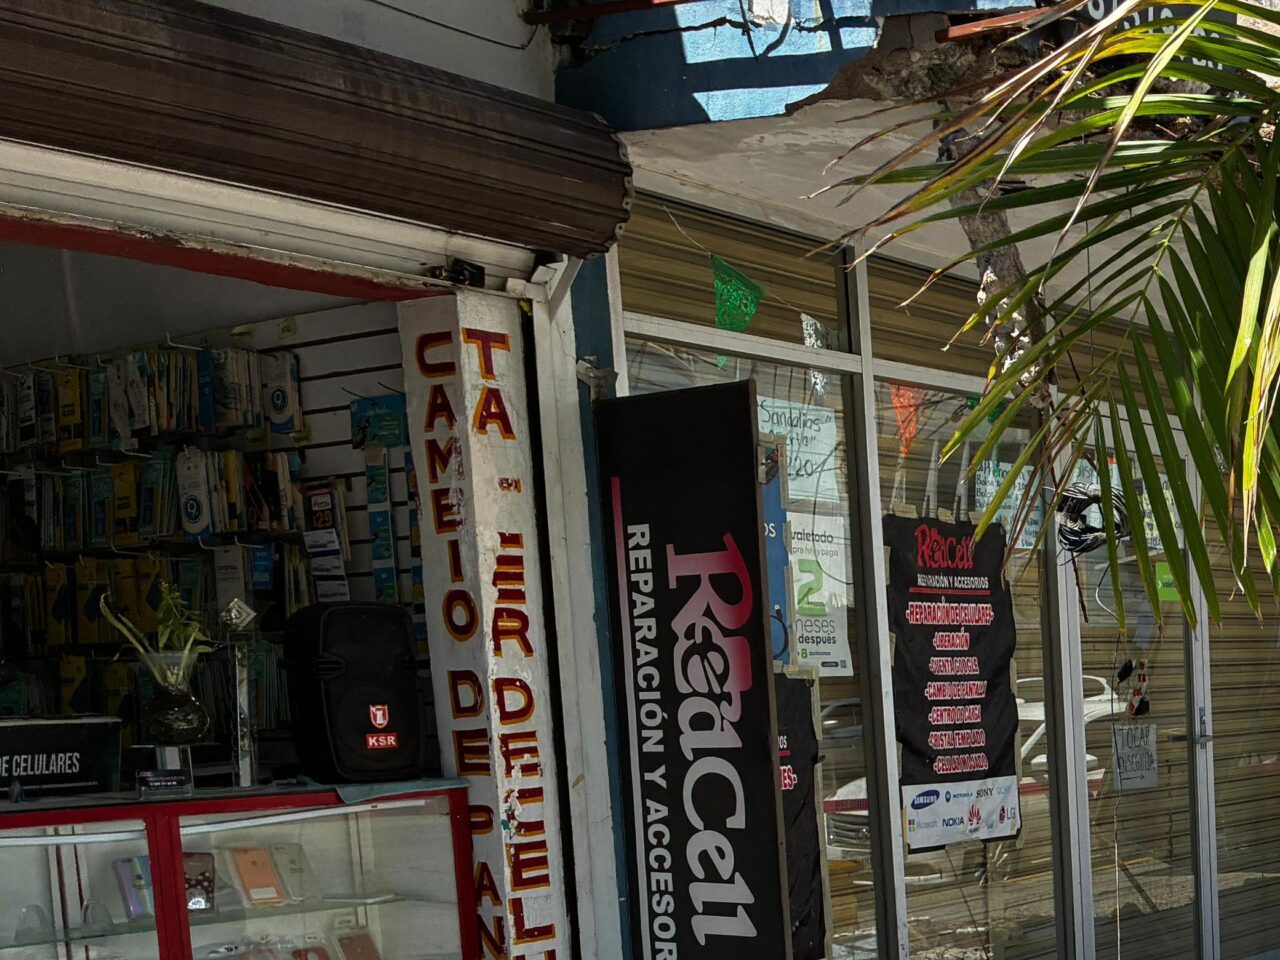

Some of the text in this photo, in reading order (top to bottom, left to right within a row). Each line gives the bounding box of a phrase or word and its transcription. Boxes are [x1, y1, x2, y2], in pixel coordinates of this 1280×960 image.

[917, 572, 990, 589] REPARACIÓN Y ACCESORIOS
[950, 604, 960, 624] DE
[627, 522, 667, 753] REPARACIÓN
[798, 633, 836, 645] después
[951, 682, 962, 699] DE
[447, 669, 493, 778] DE
[492, 677, 543, 779] DE
[368, 735, 397, 747] KSR
[12, 751, 81, 777] CELULARES
[643, 767, 668, 791] Y
[976, 788, 993, 799] SONY
[942, 816, 964, 828] NOKIA
[1006, 807, 1015, 820] LG
